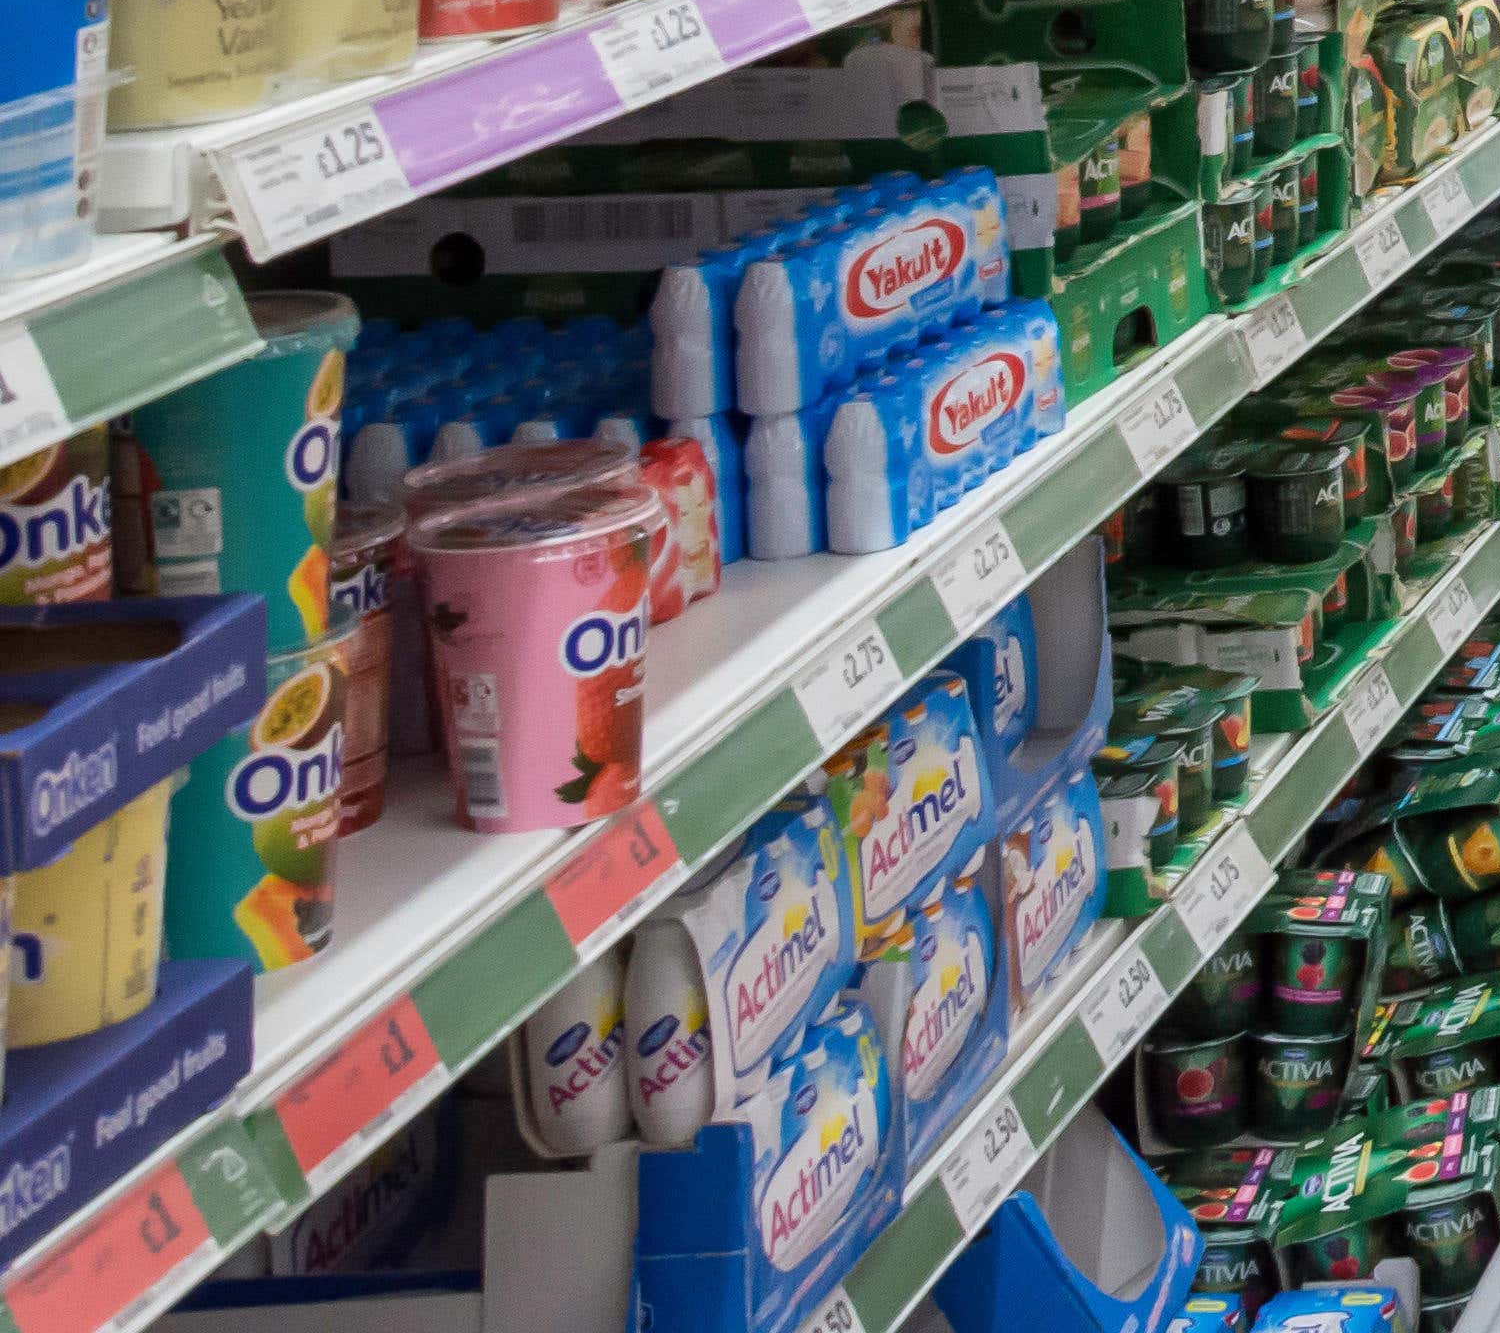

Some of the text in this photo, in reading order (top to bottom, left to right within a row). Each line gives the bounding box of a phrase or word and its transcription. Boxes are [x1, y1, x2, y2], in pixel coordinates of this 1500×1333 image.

[651, 4, 701, 47] £1.25
[314, 121, 384, 180] £1.25
[864, 236, 948, 301] Yakult
[944, 370, 1010, 435] Yakult
[841, 635, 885, 688] £2.75
[868, 759, 967, 893] Actimel
[1021, 840, 1088, 953] Actimel
[1209, 855, 1240, 905] £1.75
[735, 895, 827, 1039] Actimel
[1119, 958, 1152, 1007] £2.50
[381, 1018, 417, 1074] £1
[905, 960, 975, 1075] Actimel
[984, 1106, 1021, 1163] £2.50
[769, 1103, 863, 1258] Actimel
[1321, 1131, 1366, 1214] ACTIVIA
[139, 1194, 181, 1253] £1
